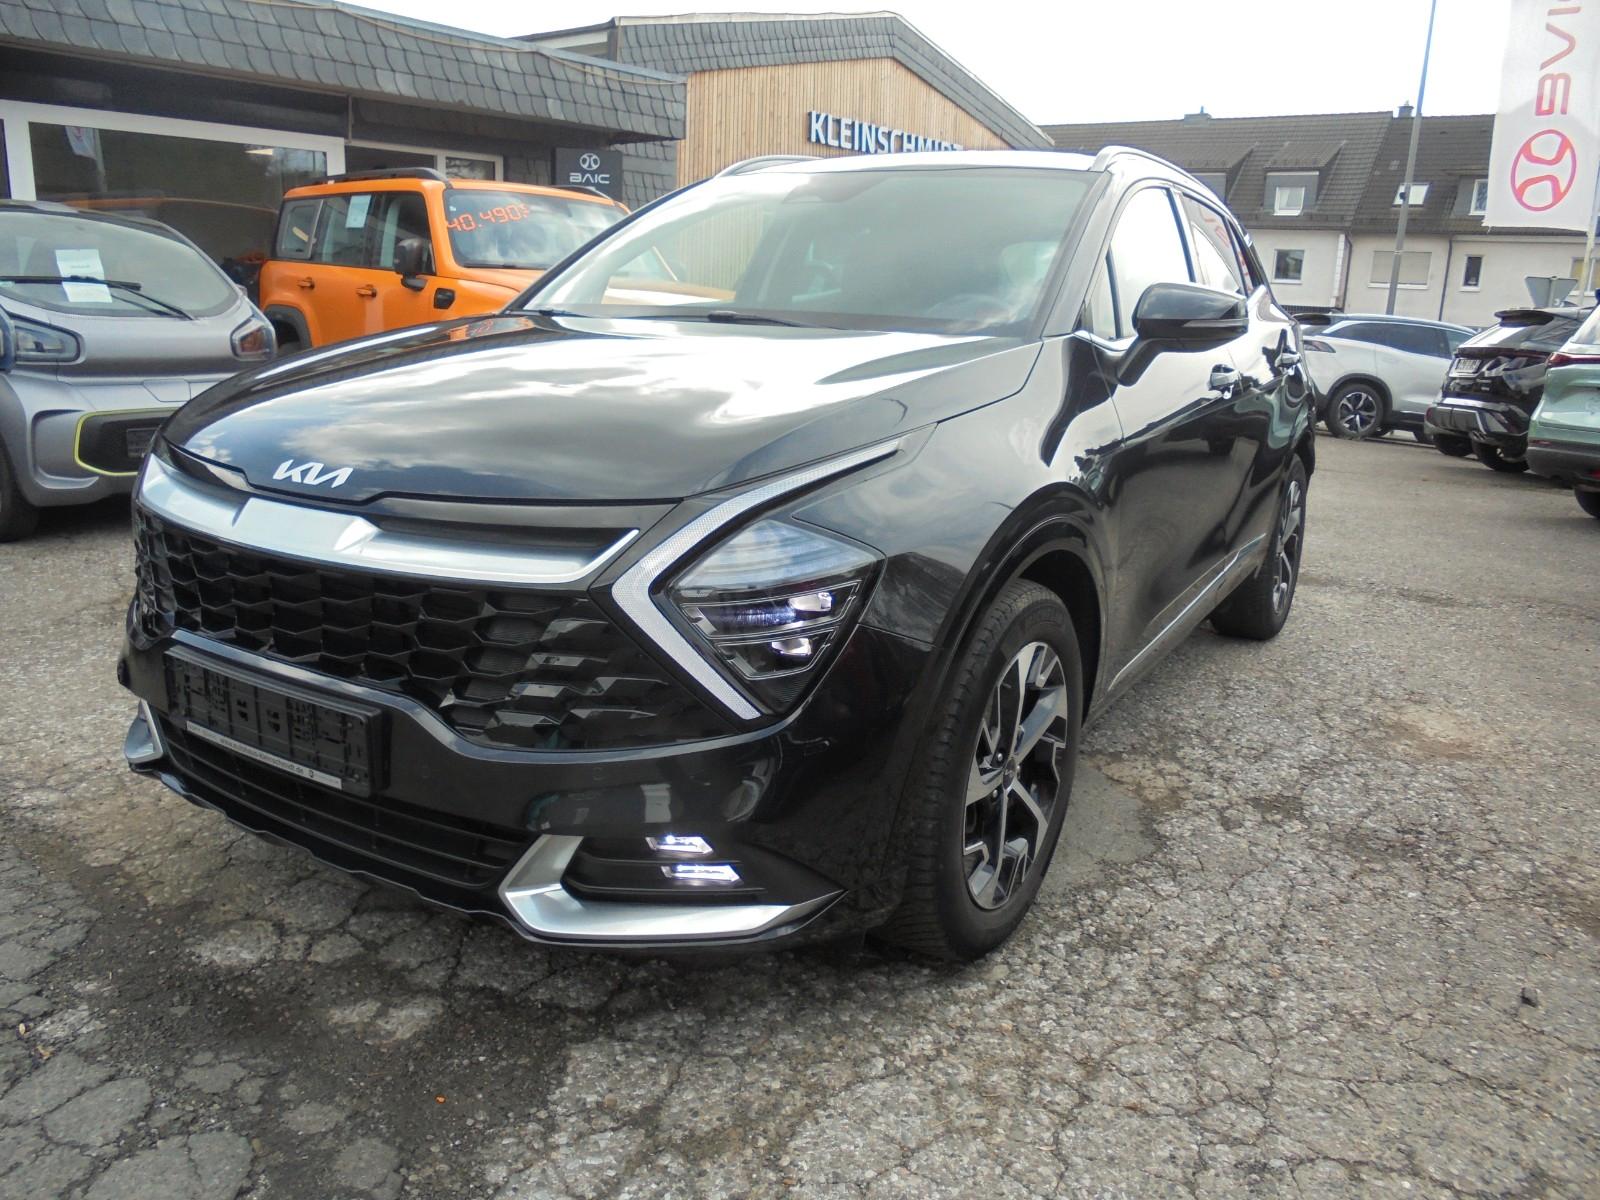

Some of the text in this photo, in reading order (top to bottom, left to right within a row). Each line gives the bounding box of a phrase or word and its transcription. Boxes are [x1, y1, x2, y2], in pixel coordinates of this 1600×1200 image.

[1535, 0, 1582, 116] BAI
[808, 110, 963, 154] KLEINSCHM
[569, 172, 611, 184] BAIC
[272, 459, 354, 489] KIA
